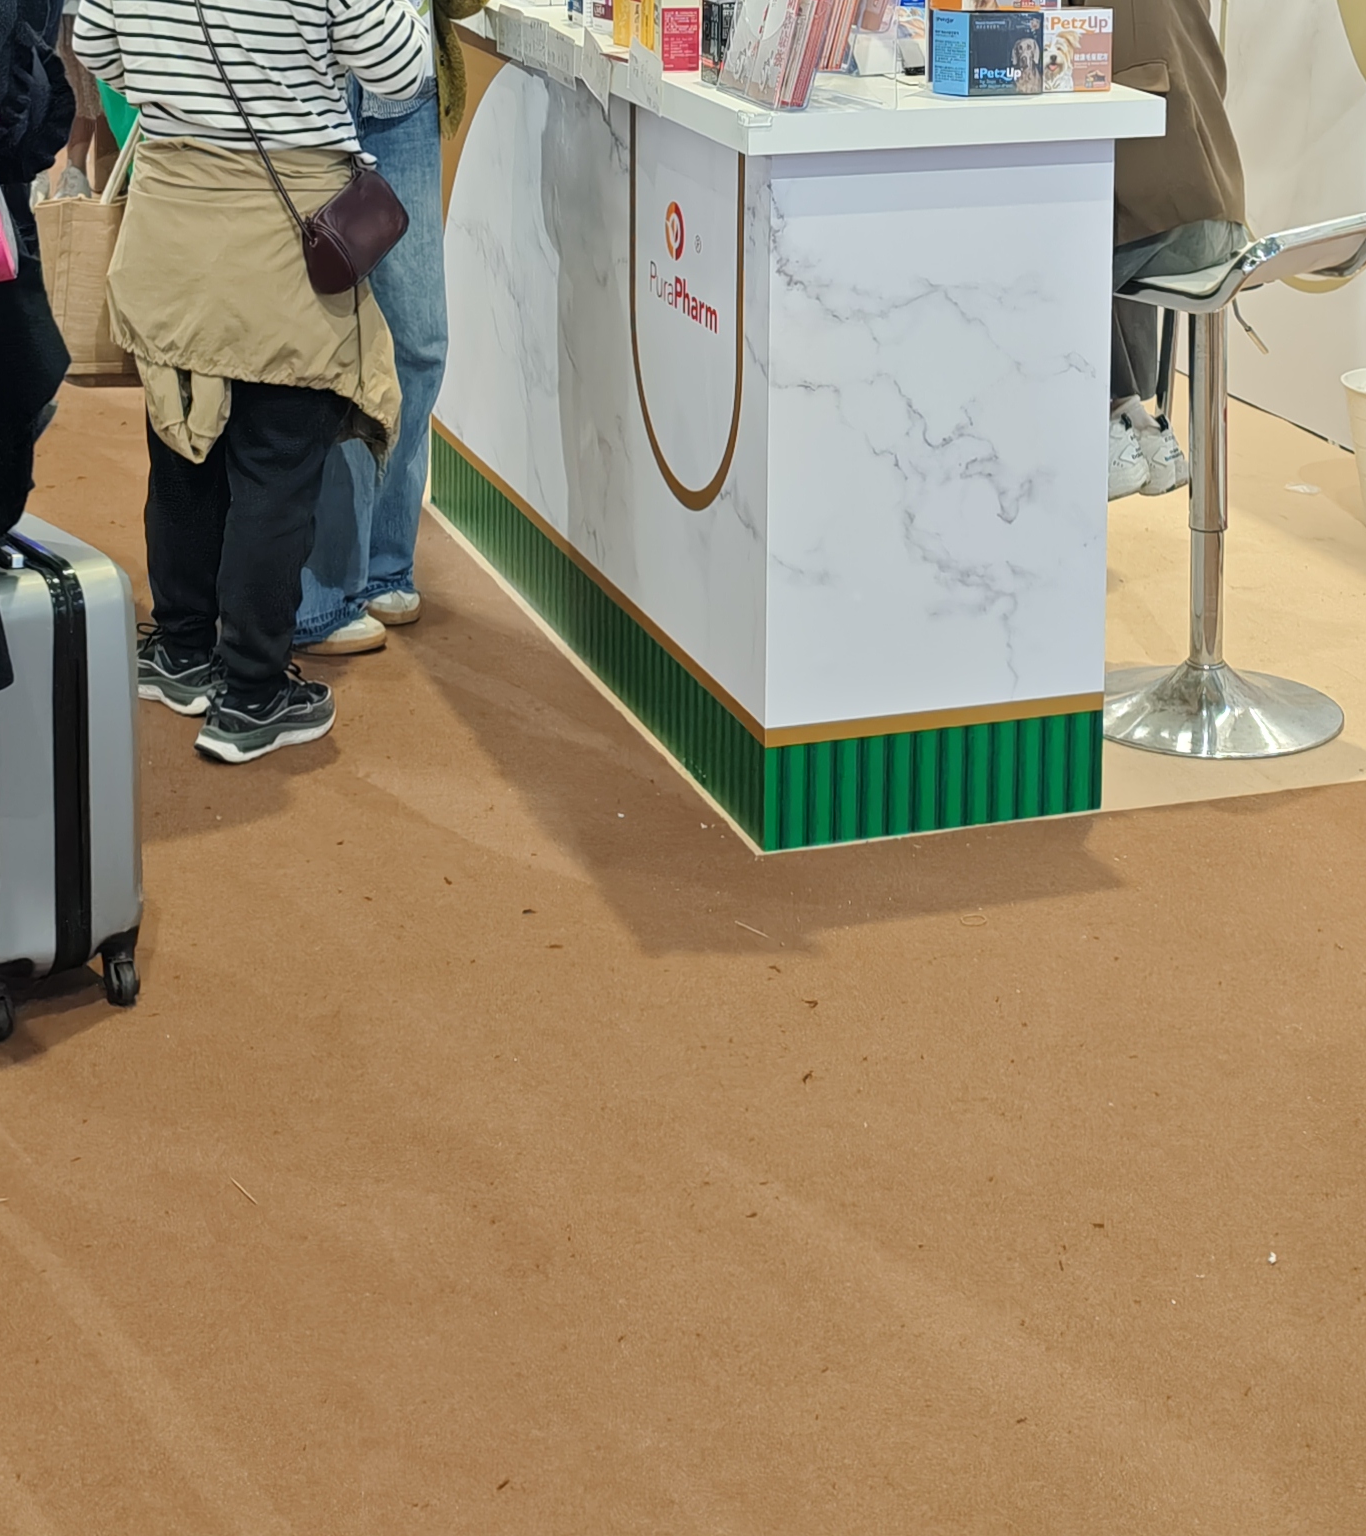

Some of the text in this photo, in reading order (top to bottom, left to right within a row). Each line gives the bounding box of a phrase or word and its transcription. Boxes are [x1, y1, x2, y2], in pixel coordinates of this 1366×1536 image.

[1050, 15, 1109, 34] PetzUp
[979, 67, 1022, 81] PetzUp
[649, 260, 719, 335] PuraPharm
